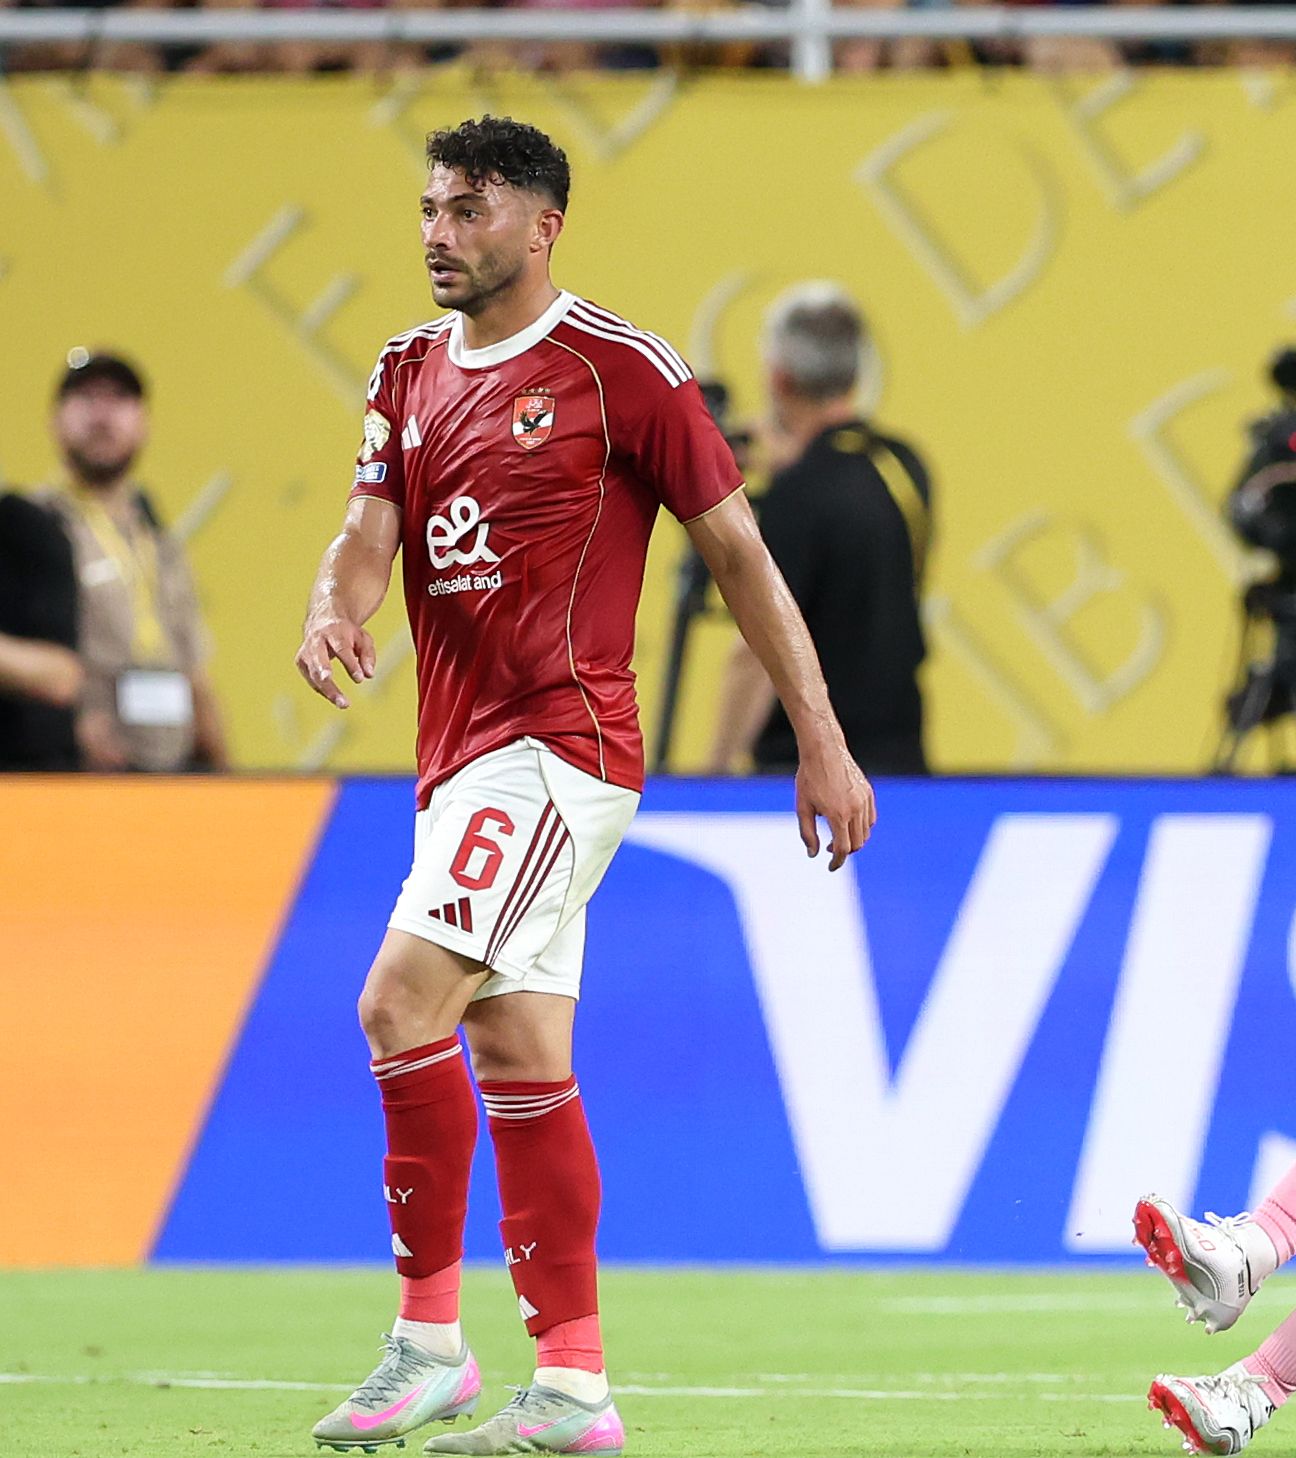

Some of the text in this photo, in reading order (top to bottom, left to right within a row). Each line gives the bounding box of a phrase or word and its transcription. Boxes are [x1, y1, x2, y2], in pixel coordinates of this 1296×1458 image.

[428, 570, 502, 596] etisalat and
[449, 807, 515, 891] 6
